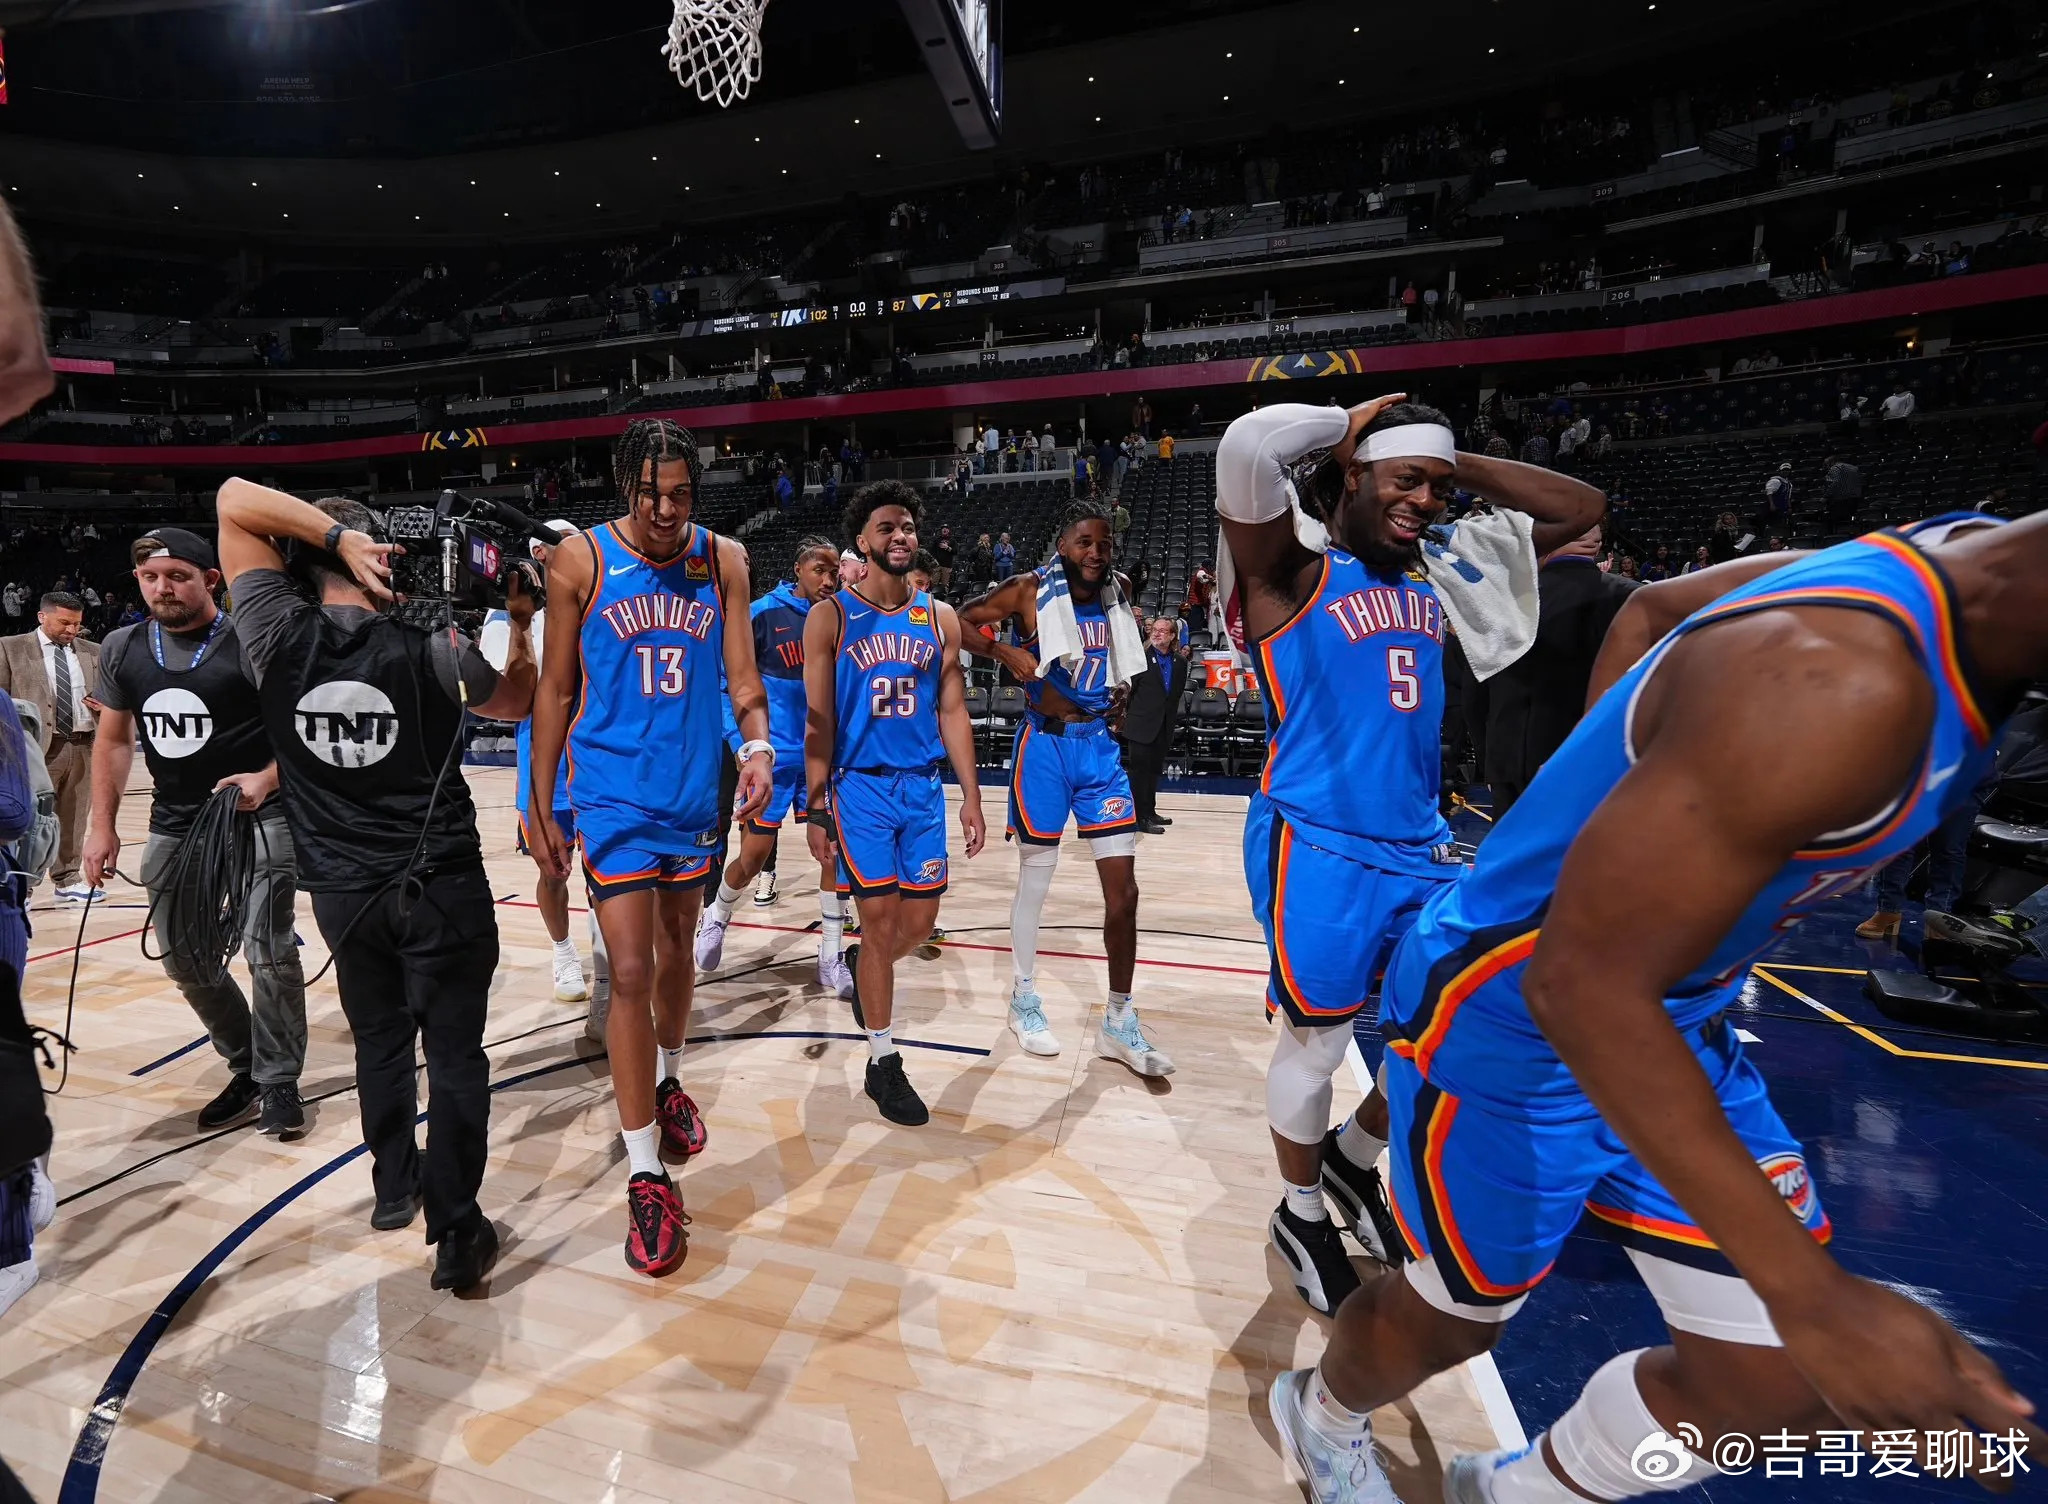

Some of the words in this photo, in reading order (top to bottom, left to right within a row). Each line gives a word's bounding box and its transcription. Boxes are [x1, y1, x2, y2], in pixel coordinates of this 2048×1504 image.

[1595, 187, 1613, 197] 309
[1272, 238, 1287, 247] 305
[956, 287, 981, 297] REBOUNDS
[982, 285, 1000, 294] LEADER
[1611, 290, 1630, 301] 206
[849, 301, 866, 313] 0.0
[892, 300, 906, 312] 87
[945, 299, 951, 307] 2
[810, 309, 828, 321] 102
[877, 307, 883, 315] 2
[735, 315, 750, 323] LEADER
[1274, 323, 1290, 332] 204
[983, 353, 996, 361] 202
[601, 593, 717, 641] THUNDER
[845, 632, 937, 673] THUNDER
[635, 645, 687, 697] 13
[1216, 666, 1231, 682] G
[1386, 645, 1422, 713] 5
[871, 675, 917, 719] 25
[142, 711, 214, 739] TNT
[294, 709, 399, 746] TNT
